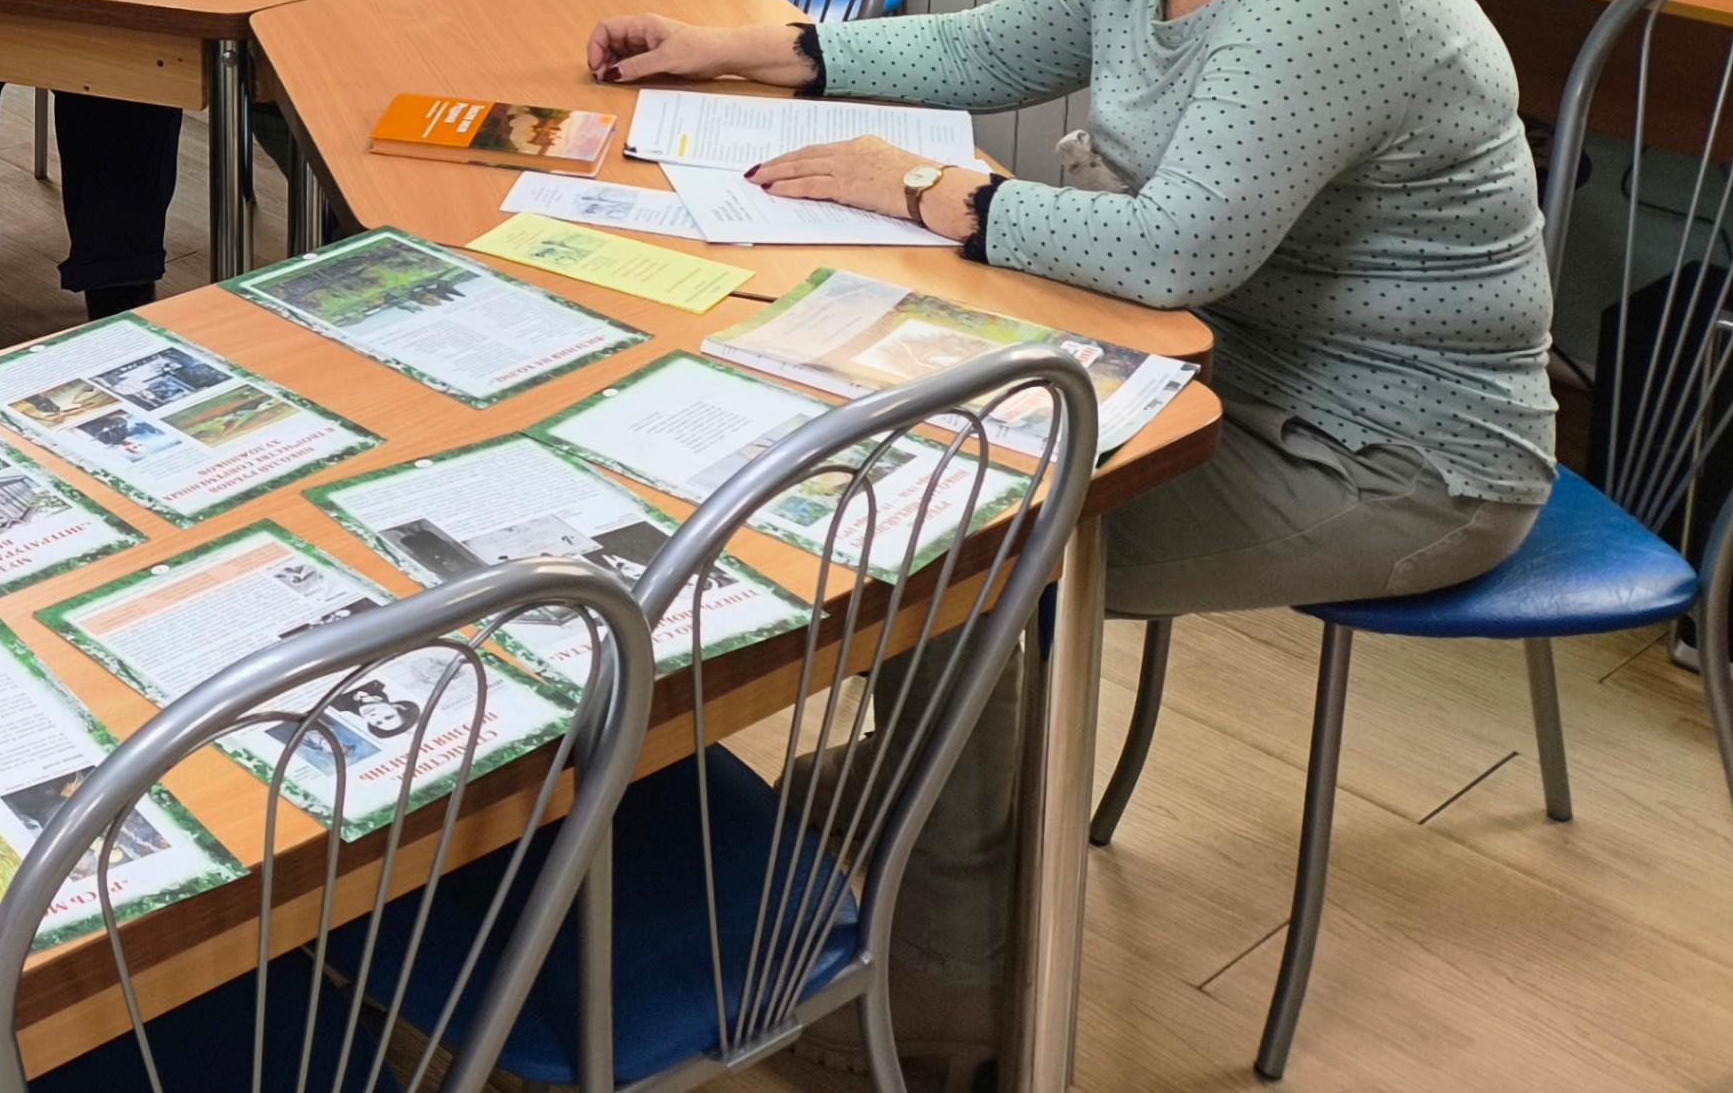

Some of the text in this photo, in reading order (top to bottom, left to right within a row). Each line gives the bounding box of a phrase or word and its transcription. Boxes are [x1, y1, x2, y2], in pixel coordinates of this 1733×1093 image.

[161, 426, 335, 503] В ТВОРЧЕСТВЕ СОВРЕМЕННЫХ
[196, 439, 282, 477] ХУДОЖНИКОВ
[206, 446, 316, 495] НИКОЛАЙ РУБЦОВ
[432, 711, 499, 746] ПЭЗИЯ
